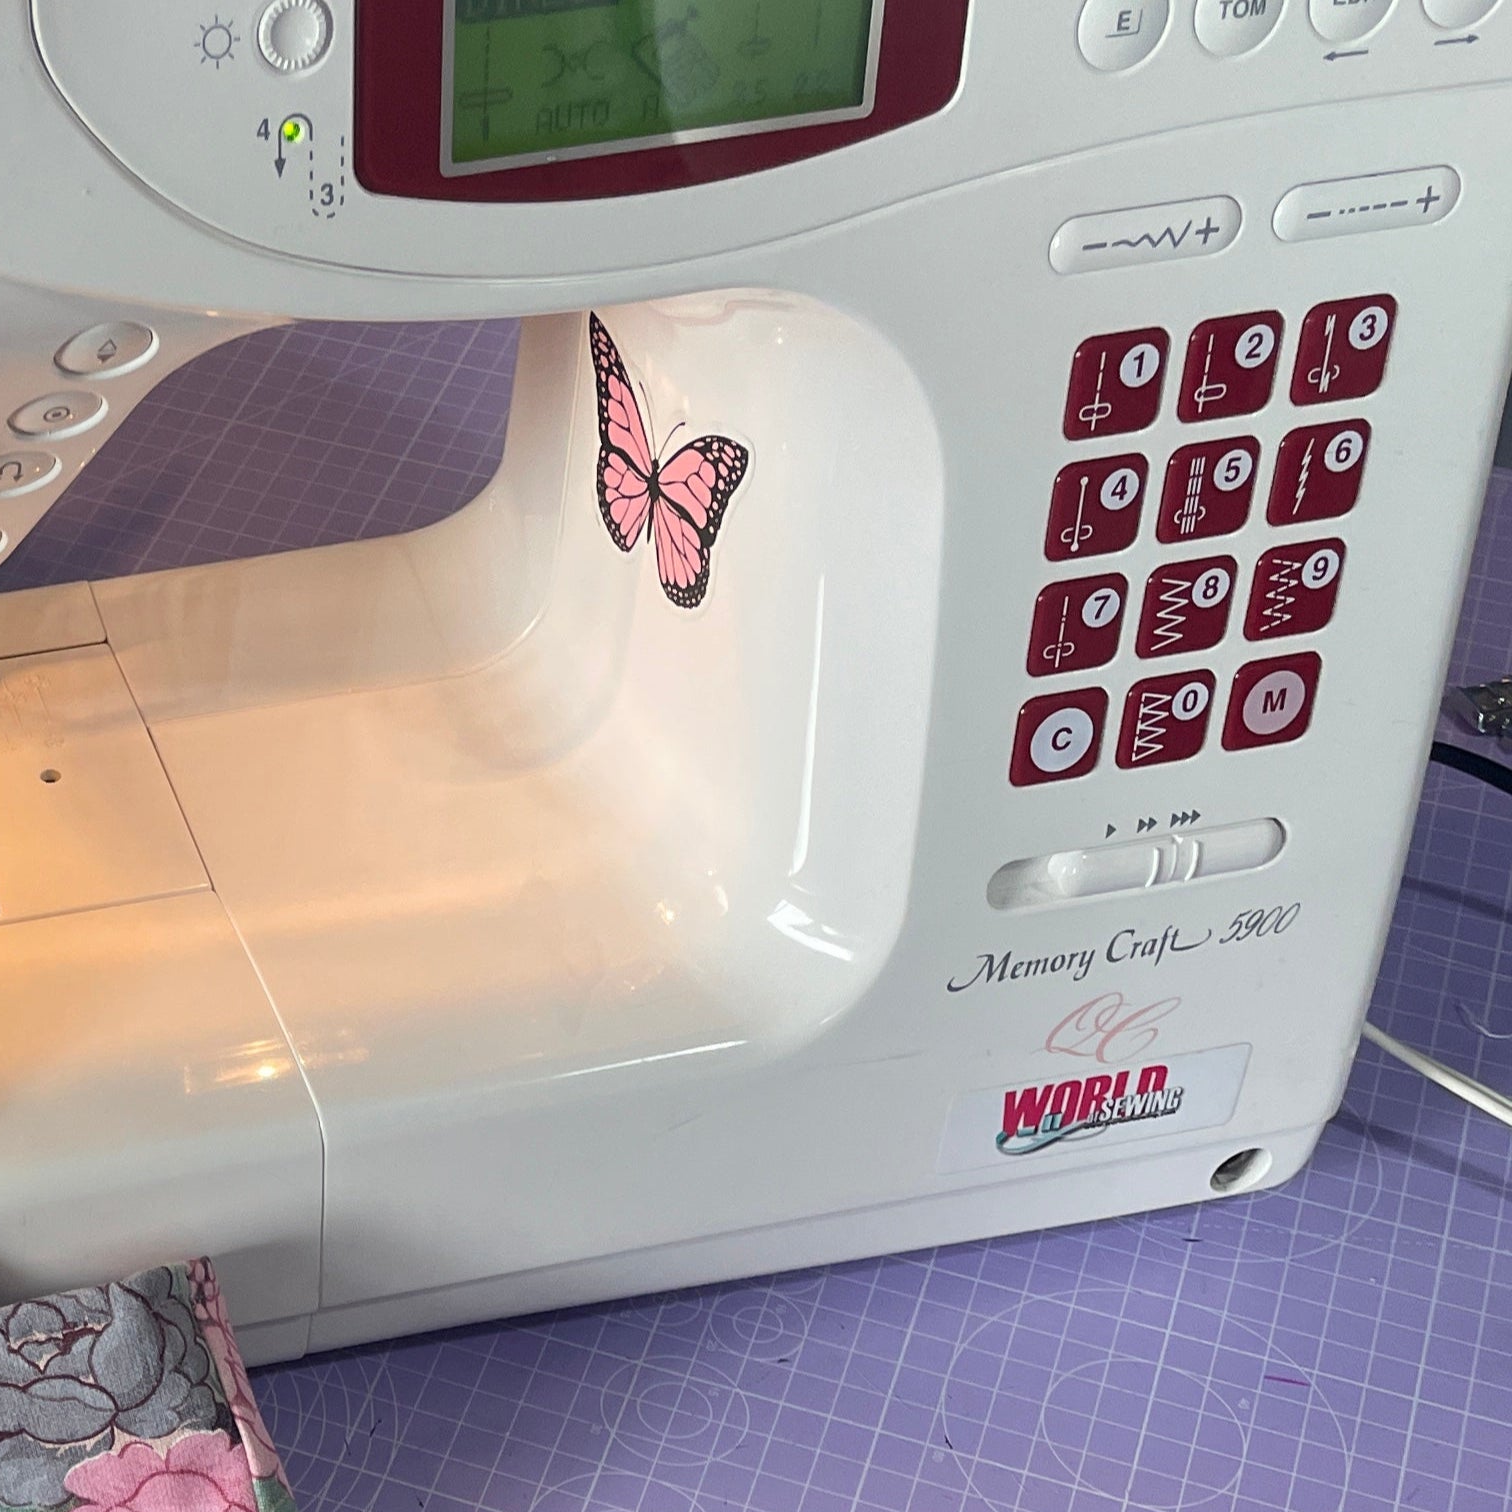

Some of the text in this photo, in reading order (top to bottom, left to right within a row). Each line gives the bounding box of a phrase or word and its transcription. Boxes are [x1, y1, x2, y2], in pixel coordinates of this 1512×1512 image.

[1116, 11, 1131, 31] E
[256, 118, 271, 141] 4
[320, 183, 334, 206] 3
[1362, 315, 1377, 341] 3
[1245, 333, 1264, 358] 2
[1132, 352, 1146, 378] 1
[1336, 438, 1351, 463] 6
[1225, 456, 1241, 481] 5
[1111, 475, 1129, 501] 4
[1312, 556, 1328, 581] 9
[1202, 575, 1219, 600] 8
[1095, 596, 1111, 620] 7
[1182, 690, 1199, 715] 0
[1262, 690, 1287, 714] M
[1051, 728, 1073, 752] C
[946, 902, 1301, 993] Memory Craft 5900
[1001, 1064, 1170, 1138] WORLD
[1099, 1086, 1184, 1122] SEWING
